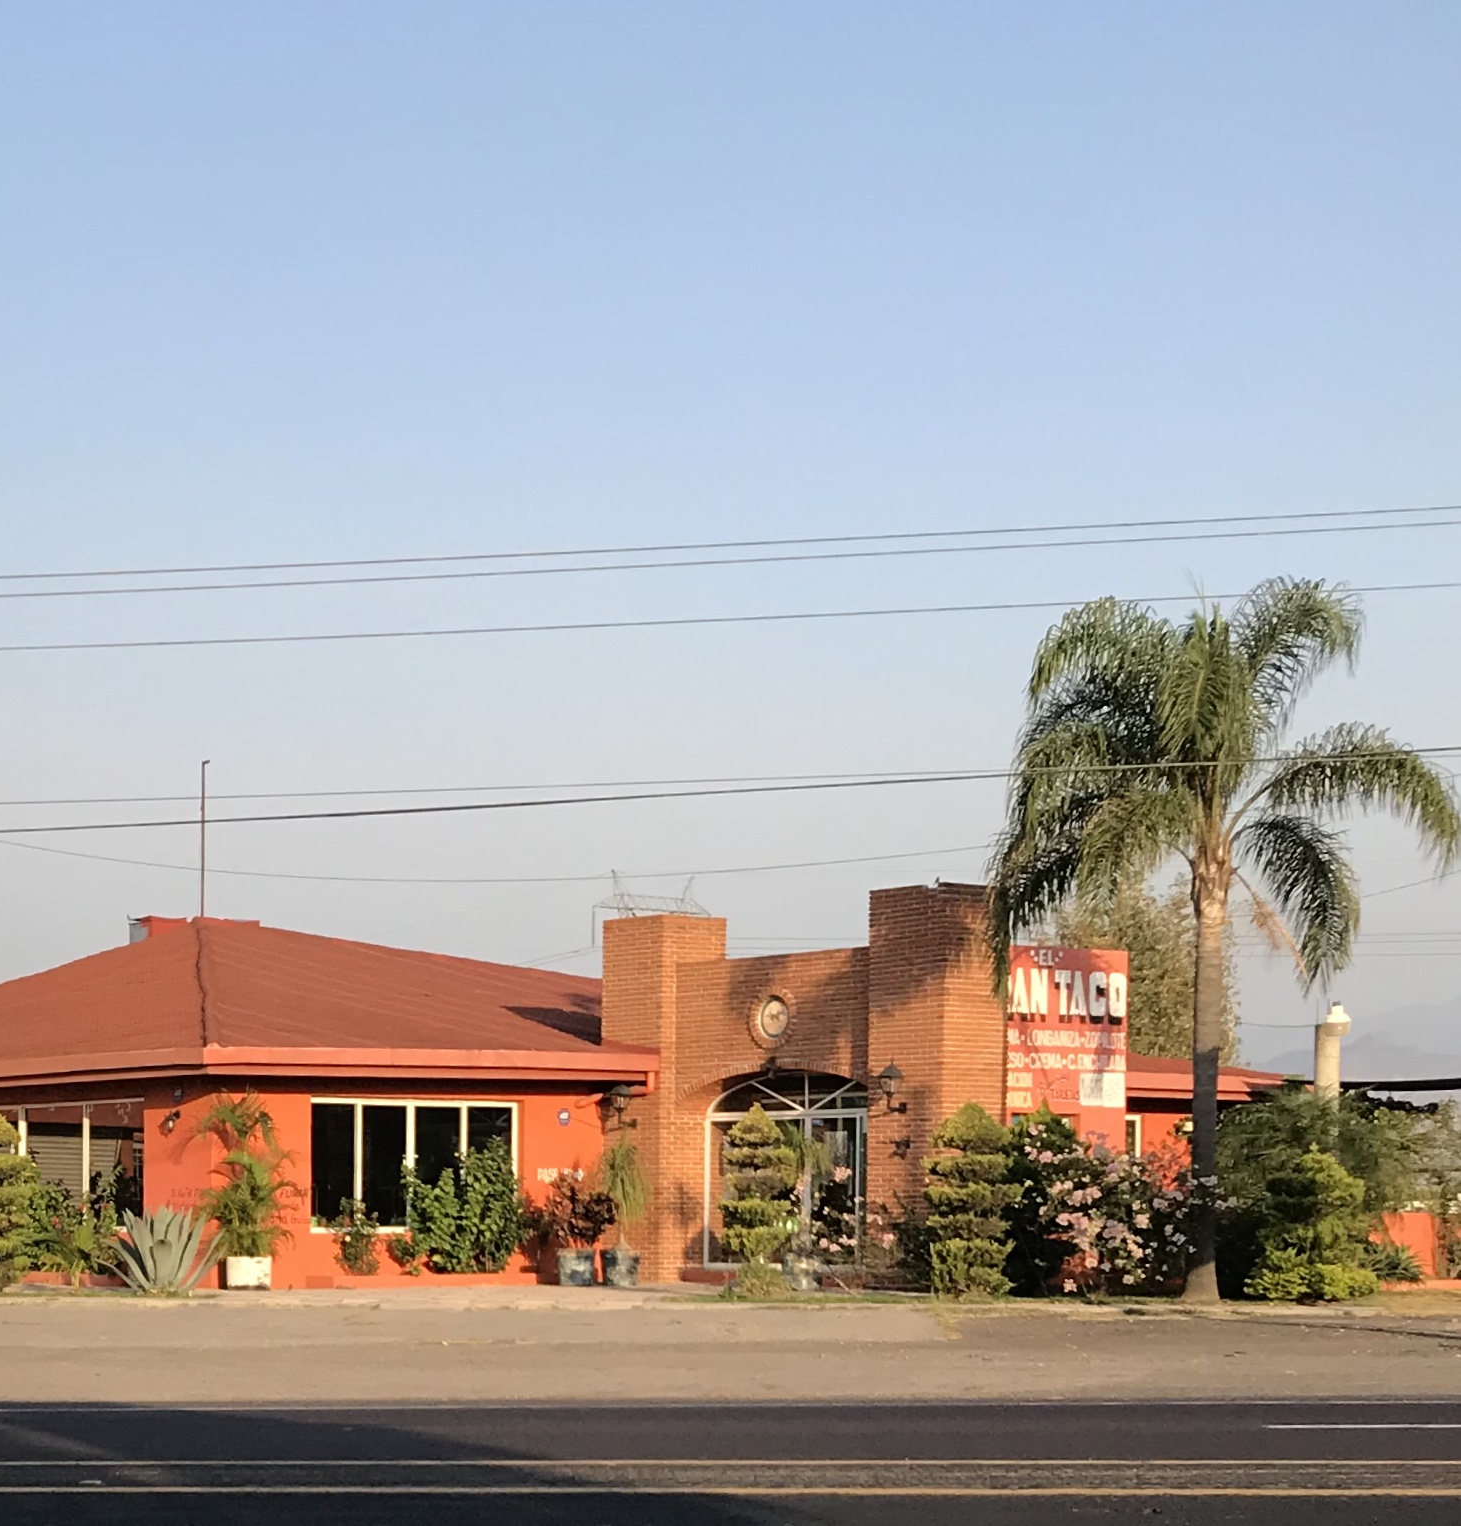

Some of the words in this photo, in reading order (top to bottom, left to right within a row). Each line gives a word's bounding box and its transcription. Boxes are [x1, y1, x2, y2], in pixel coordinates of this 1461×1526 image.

[1039, 949, 1054, 968] EL
[1054, 970, 1127, 1025] TACO
[1029, 1052, 1063, 1069] CREMA
